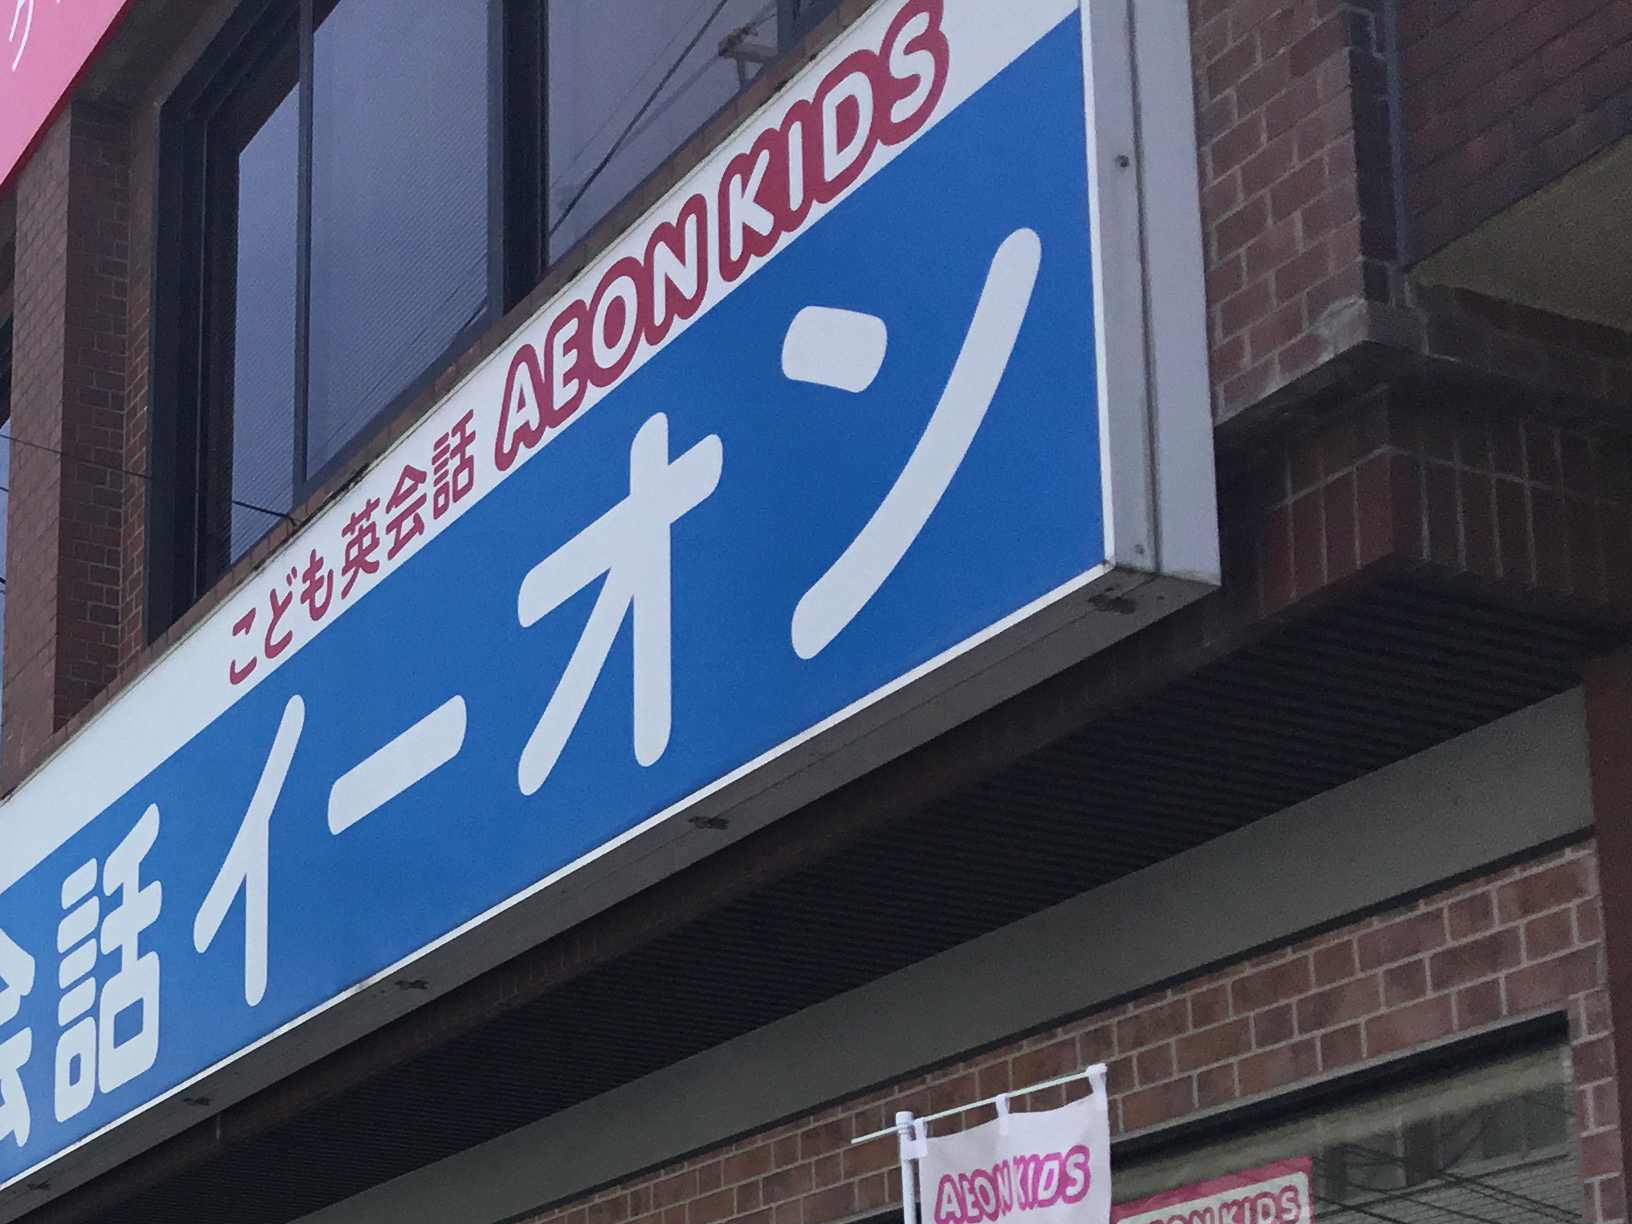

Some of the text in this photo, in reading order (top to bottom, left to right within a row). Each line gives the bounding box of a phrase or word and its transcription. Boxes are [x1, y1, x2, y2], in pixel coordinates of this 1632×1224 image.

[229, 0, 950, 685] こども英会話 AEON KIDS
[1013, 1144, 1091, 1211] KIDS
